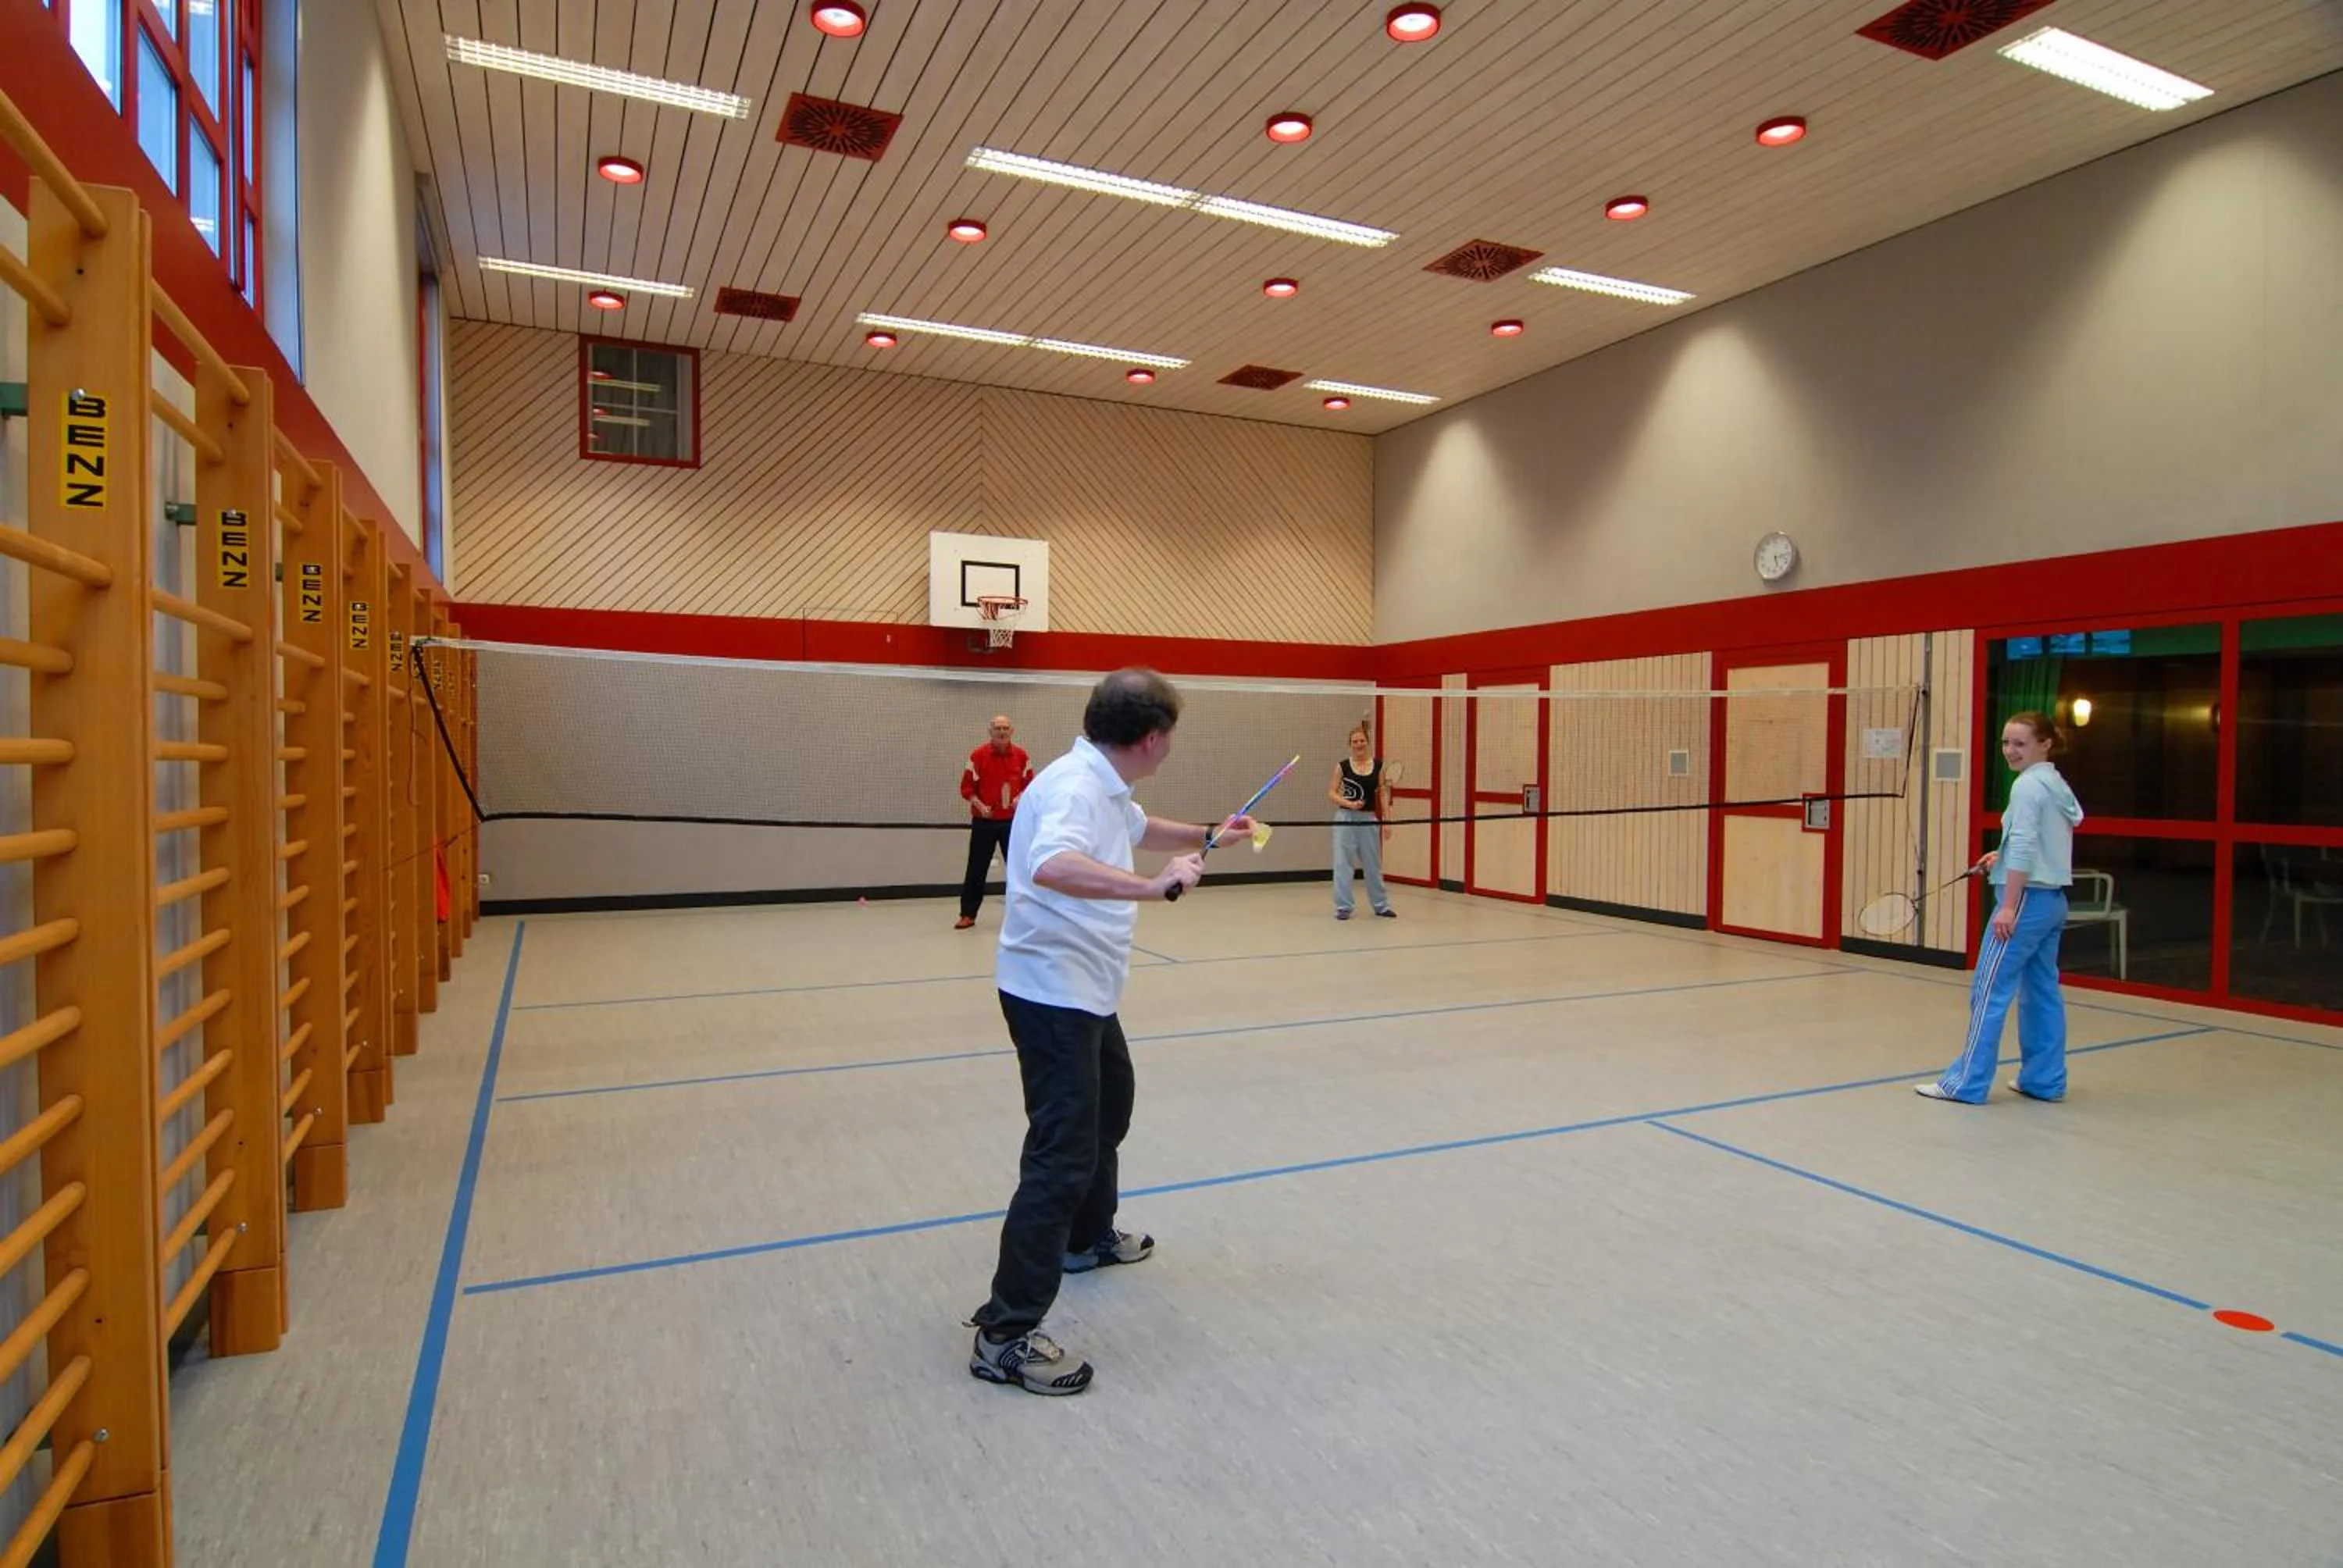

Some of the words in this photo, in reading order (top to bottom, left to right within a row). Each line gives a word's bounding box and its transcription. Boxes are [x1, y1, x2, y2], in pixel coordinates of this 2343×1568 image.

[66, 391, 105, 507] BENZ
[222, 511, 247, 587] BENZ
[302, 565, 321, 622] BENZ
[352, 602, 367, 648] BENZ
